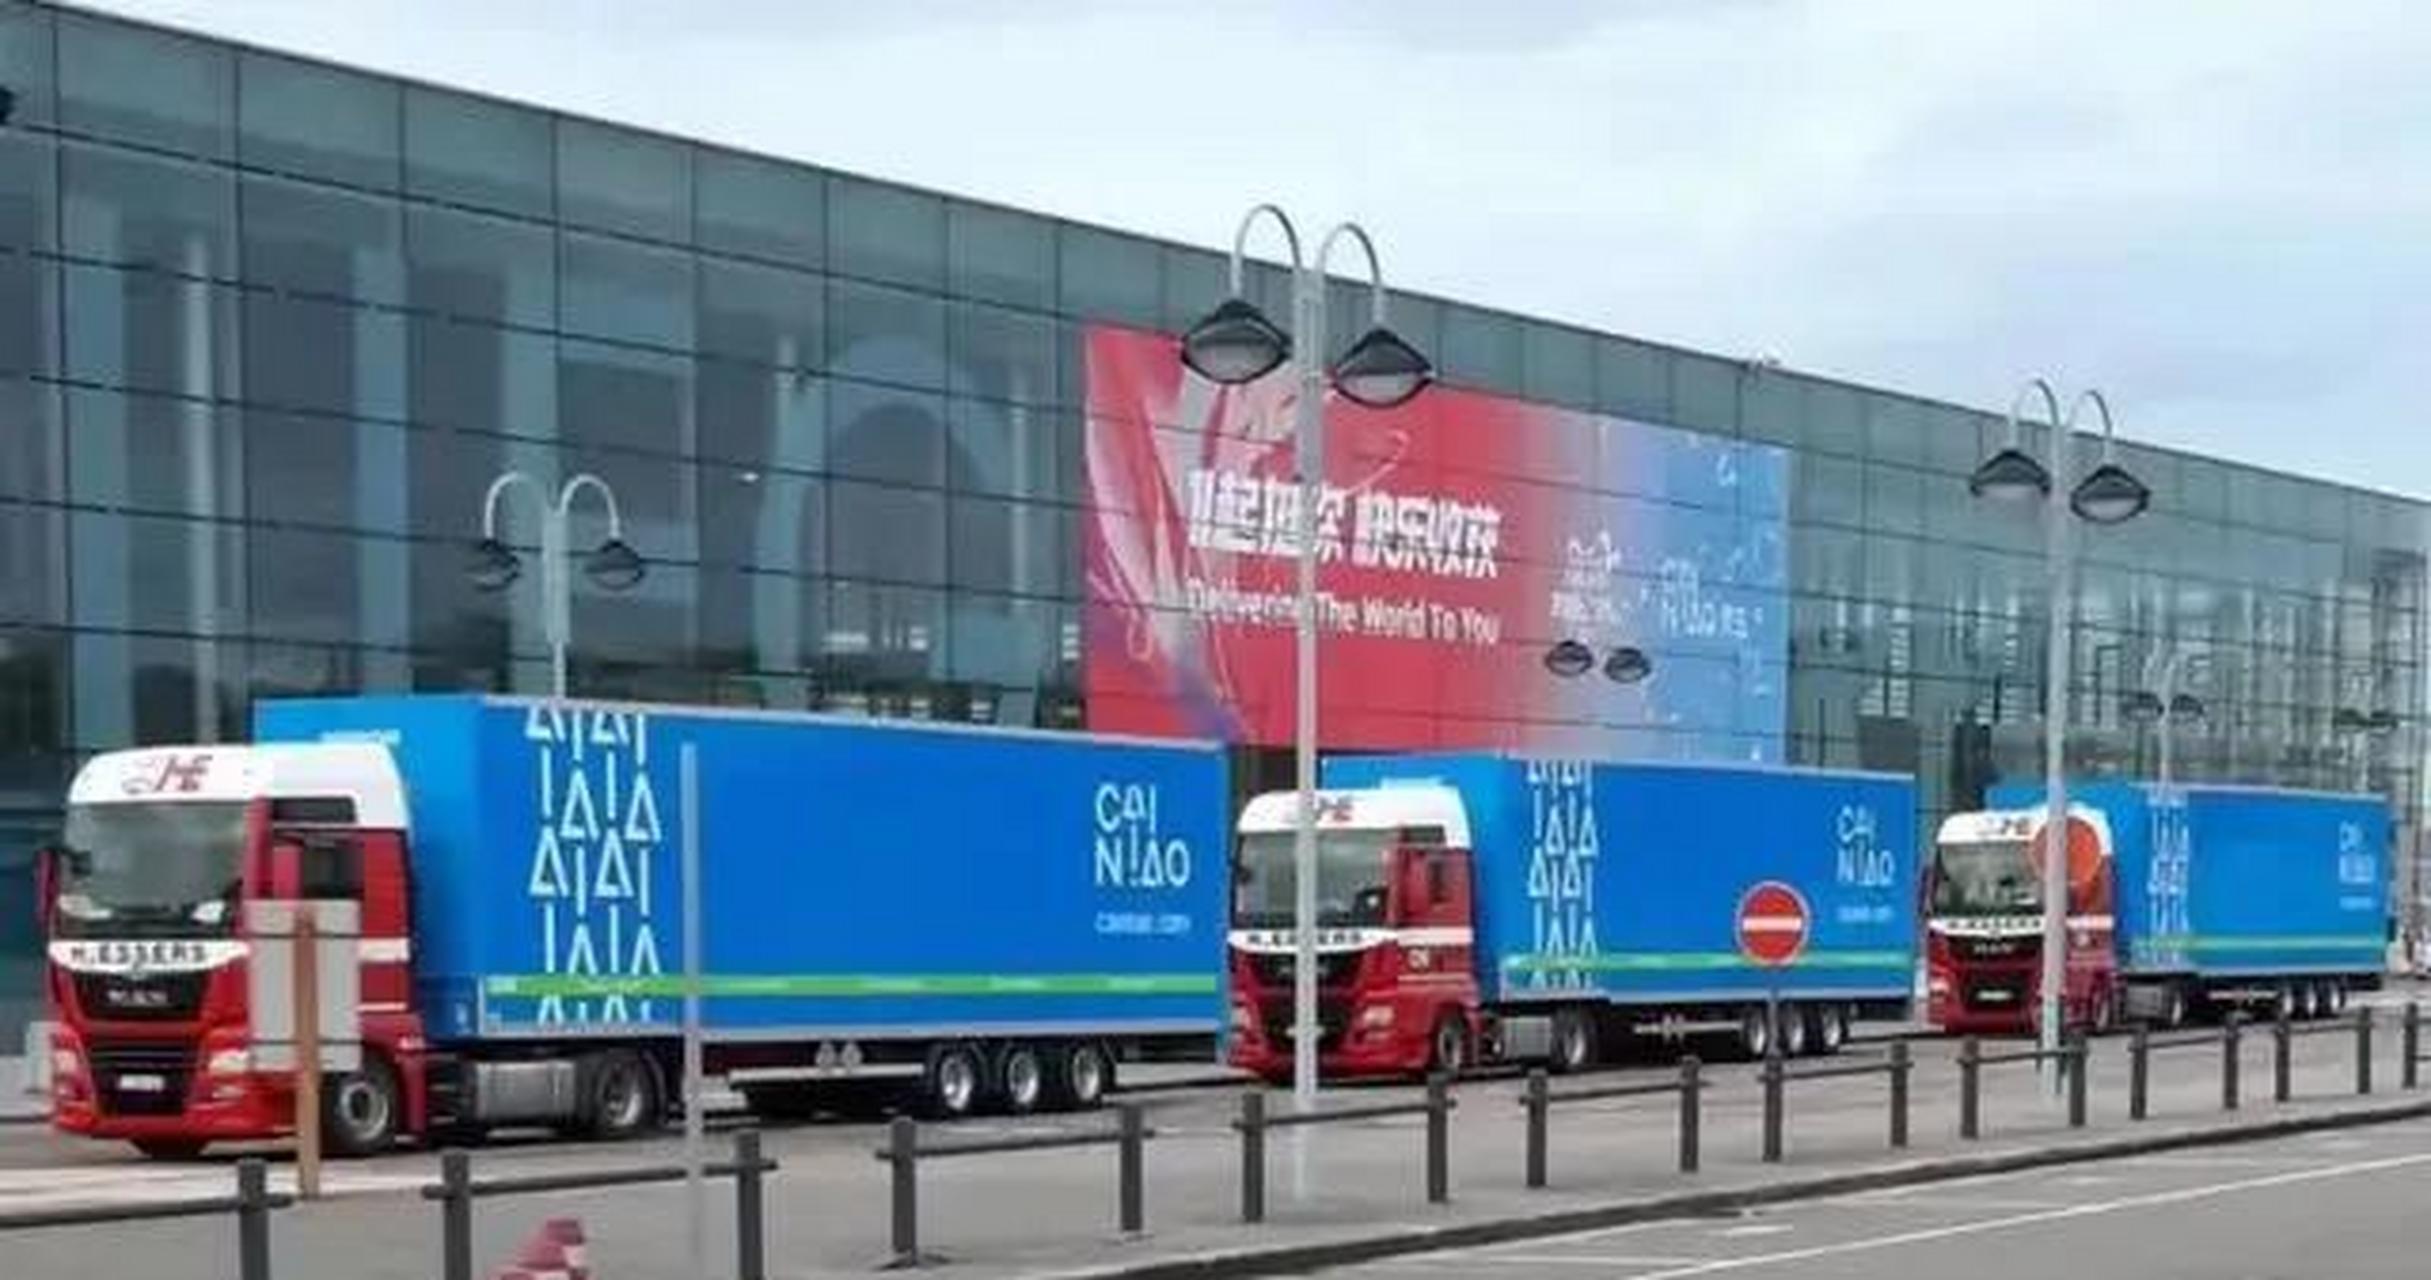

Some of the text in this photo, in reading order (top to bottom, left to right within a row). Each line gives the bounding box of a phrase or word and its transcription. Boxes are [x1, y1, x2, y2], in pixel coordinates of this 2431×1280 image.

[1185, 577, 1500, 646] Deliverin The World To You
[1096, 783, 1156, 833] CAI
[1096, 830, 1190, 886] NIAO
